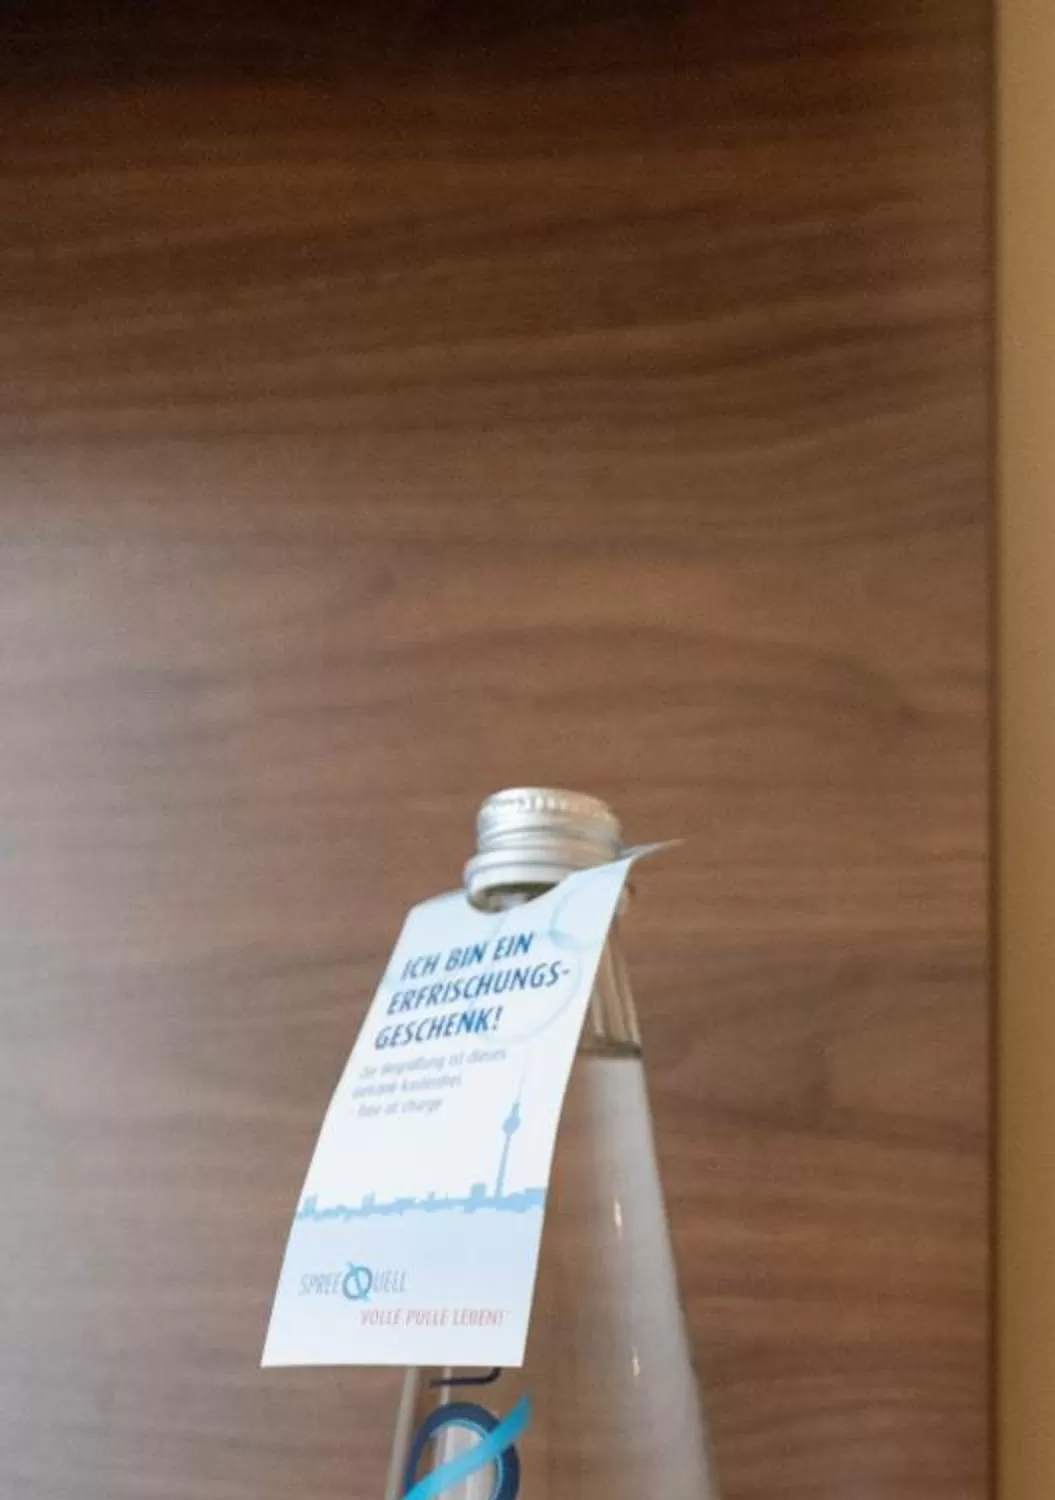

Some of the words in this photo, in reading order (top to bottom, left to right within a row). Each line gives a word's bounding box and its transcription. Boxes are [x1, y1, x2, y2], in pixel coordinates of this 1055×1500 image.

[401, 952, 441, 981] ICH
[444, 942, 488, 972] BIN
[493, 931, 535, 958] EIN
[386, 960, 570, 1016] ERFRISCHUNGS-
[374, 1006, 504, 1050] GESCHENK!
